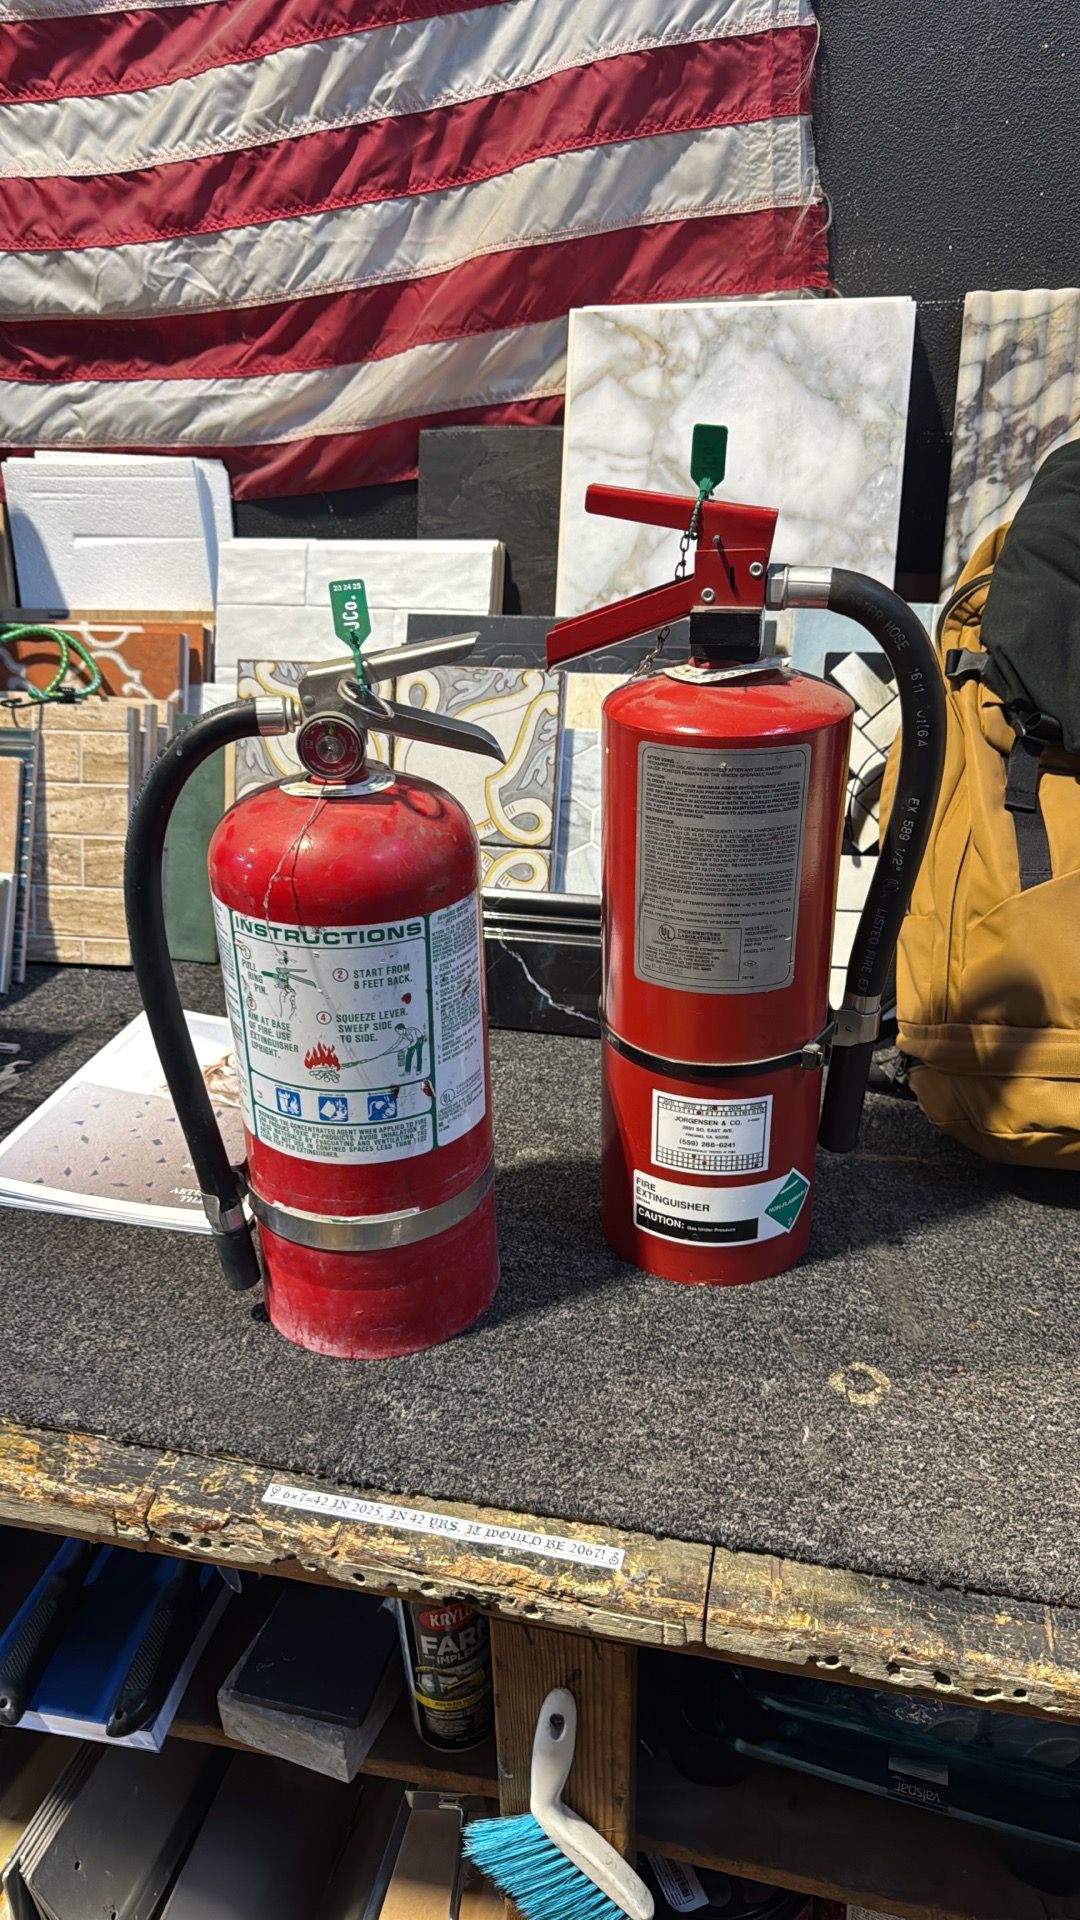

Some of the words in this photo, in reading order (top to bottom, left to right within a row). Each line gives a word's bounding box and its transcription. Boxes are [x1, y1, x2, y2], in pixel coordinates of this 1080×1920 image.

[342, 595, 360, 631] JCo.
[883, 620, 910, 651] HOSE
[907, 797, 920, 814] EX
[899, 820, 914, 841] 589
[234, 916, 422, 945] INSTRUCTIONS
[662, 927, 672, 940] UL
[868, 909, 888, 945] LISTED
[242, 959, 258, 972] PULL
[861, 950, 876, 974] FIRE
[353, 968, 384, 978] START
[386, 963, 410, 976] FROM
[354, 980, 360, 990] 8
[362, 979, 384, 989] FEET
[388, 974, 412, 986] BACK.
[261, 1016, 270, 1025] AT
[272, 1019, 292, 1032] BASE
[336, 1012, 376, 1024] SQUEEZE
[379, 1008, 408, 1020] LEVER.
[338, 1024, 370, 1033] SWEEP
[372, 1020, 392, 1031] SIDE
[250, 1030, 299, 1053] EXTINGUISHER
[276, 1030, 292, 1042] USE
[340, 1034, 352, 1044] TO
[355, 1034, 378, 1043] SIDE.
[290, 1122, 335, 1134] CONCENTRATED
[379, 1124, 404, 1133] APPLIED
[674, 1116, 718, 1126] JORGENSEN
[680, 1138, 698, 1147] (559)
[636, 1177, 656, 1192] FIRE
[636, 1187, 710, 1212] EXTINGUISHER
[638, 1207, 684, 1230] CAUTION:
[330, 1498, 350, 1511] IN
[351, 1502, 384, 1518] 2025,
[386, 1509, 408, 1521] IN
[410, 1514, 426, 1524] 42
[485, 1526, 542, 1546] WOULD
[545, 1538, 566, 1552] BE
[570, 1542, 606, 1560] 2067!
[896, 1781, 941, 1804] valspar
